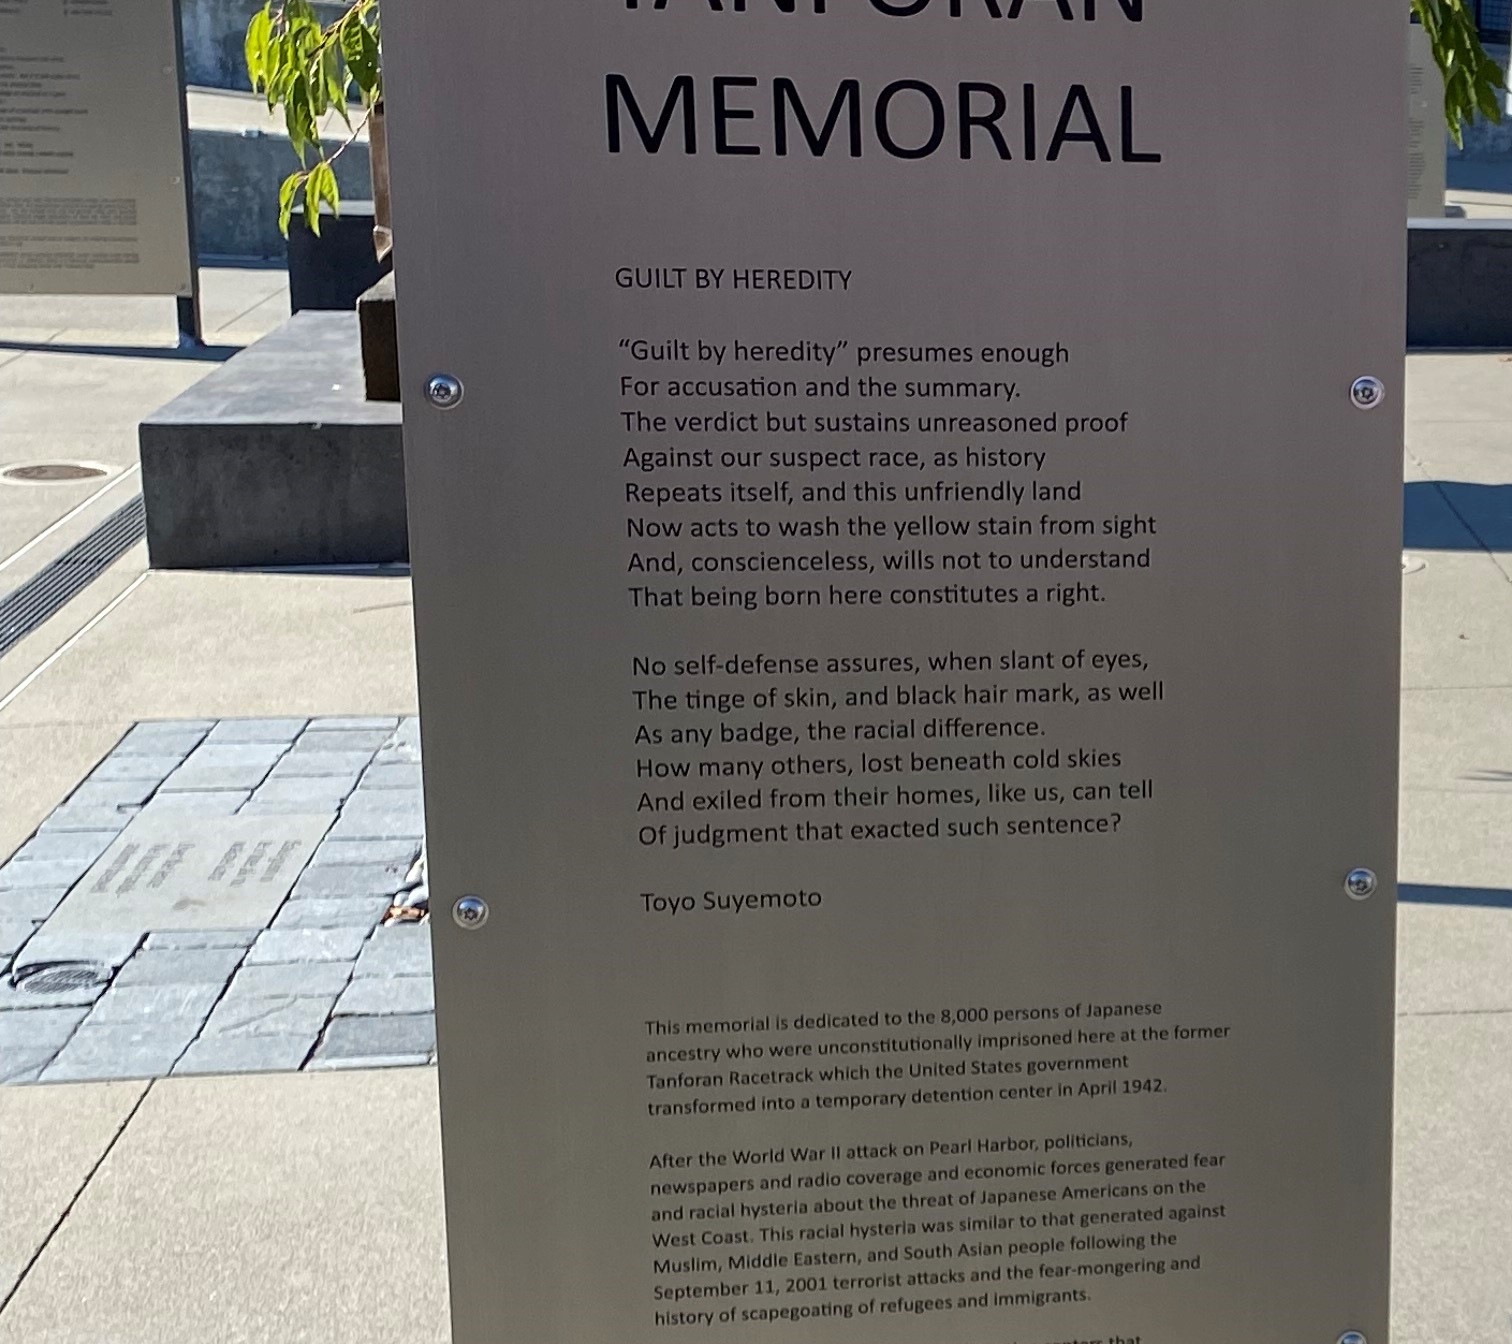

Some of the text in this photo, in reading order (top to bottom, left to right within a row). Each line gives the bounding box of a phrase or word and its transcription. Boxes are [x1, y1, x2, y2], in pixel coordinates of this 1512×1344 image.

[606, 74, 1161, 163] MEMORIAL
[616, 267, 851, 290] GUILT BY HEREDITY
[619, 338, 1068, 368] “Guilt by heredity” presumes enough
[621, 376, 1020, 402] For accusation and the summary.
[621, 410, 1128, 437] The verdict but sustains unreasoned proof
[623, 446, 1045, 472] Against our suspect race, as history
[626, 480, 1080, 507] Repeats itself, and this unfriendly land
[628, 513, 1156, 541] Now acts to wash the yellow stain from sight
[628, 547, 1149, 576] And, conscienceless, wills not to understand
[628, 581, 1105, 611] That being born here constitutes a right.
[633, 649, 1147, 676] No self-defense assures, when slant of eyes,
[632, 680, 1162, 713] The tinge of skin, and black hair mark, as well
[635, 717, 1044, 748] As any badge, the racial difference.
[637, 748, 1121, 780] How many others, lost beneath cold skies
[637, 778, 1152, 812] And exiled from their homes, like us, can tell
[639, 812, 1121, 850] Of judgment that exacted such sentence?
[640, 889, 821, 916] Toyo Suyemoto
[645, 1003, 1161, 1036] This memorial is dedicated to the 8,000 persons of Japanese
[647, 1055, 1127, 1089] Tanforan Racetrack which the United States government
[654, 1231, 1176, 1274] Muslim, Middle Eastern, and South Asian people following the
